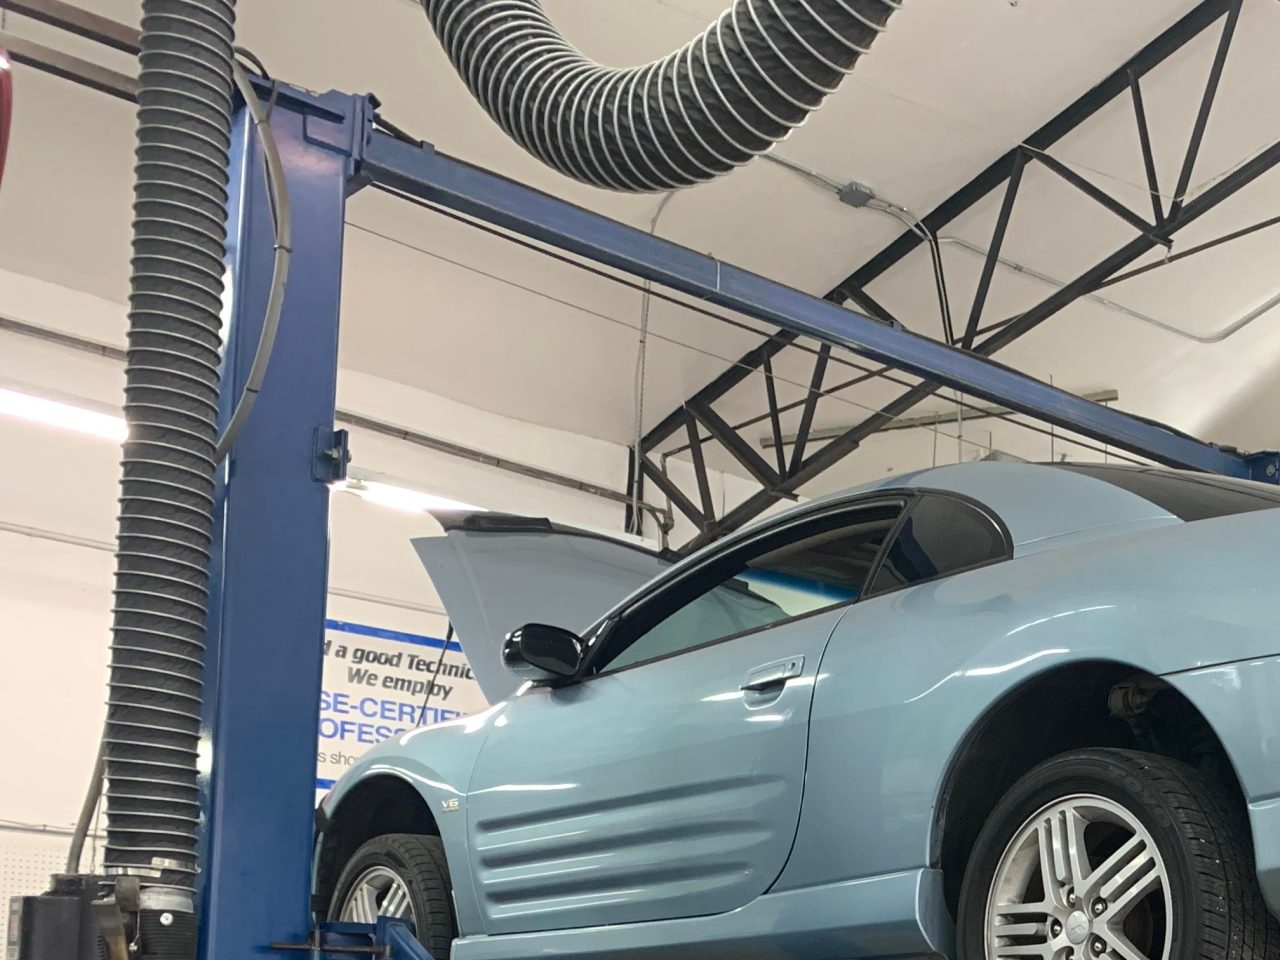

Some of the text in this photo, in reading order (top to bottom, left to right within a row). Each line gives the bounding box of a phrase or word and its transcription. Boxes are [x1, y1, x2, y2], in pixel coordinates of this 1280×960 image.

[335, 645, 347, 660] a
[352, 647, 402, 668] good
[347, 666, 453, 701] We employ
[441, 798, 459, 808] V6
